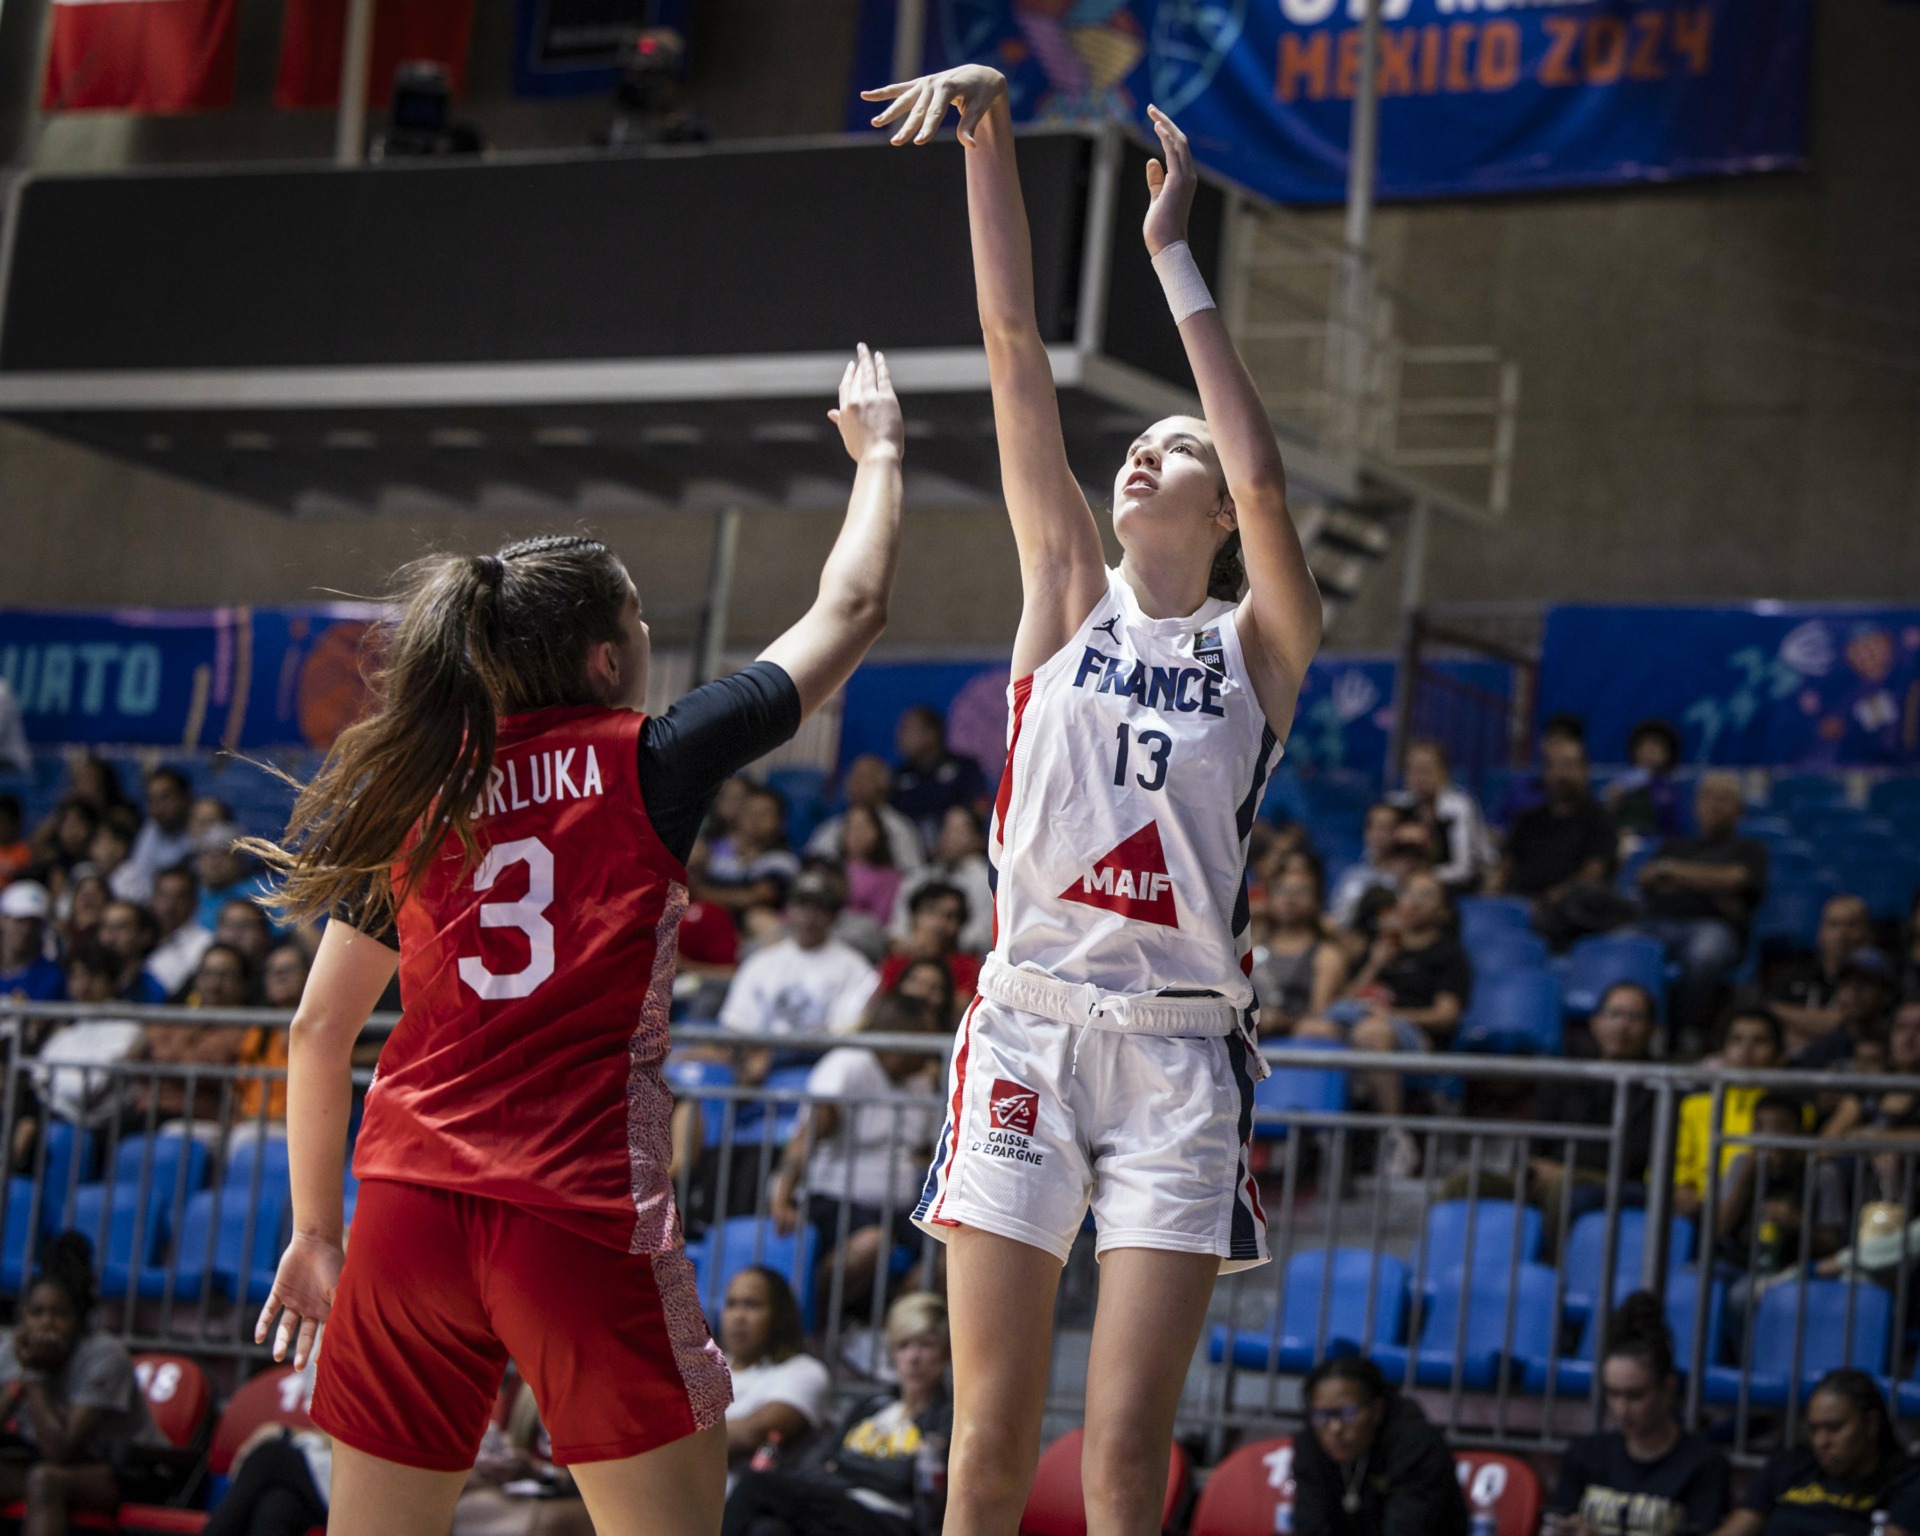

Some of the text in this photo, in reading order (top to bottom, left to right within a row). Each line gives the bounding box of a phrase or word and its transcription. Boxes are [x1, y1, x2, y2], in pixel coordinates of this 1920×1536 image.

[1275, 8, 1713, 104] MEXICO 2024
[1072, 645, 1226, 718] FRANCE
[1198, 653, 1220, 665] FIBA
[440, 744, 604, 820] RLUKA
[1113, 722, 1173, 792] 13
[457, 836, 556, 1001] 3
[1082, 866, 1172, 902] MAIF
[971, 1141, 1044, 1166] D'EPARGNE
[988, 1131, 1030, 1149] CAISSE
